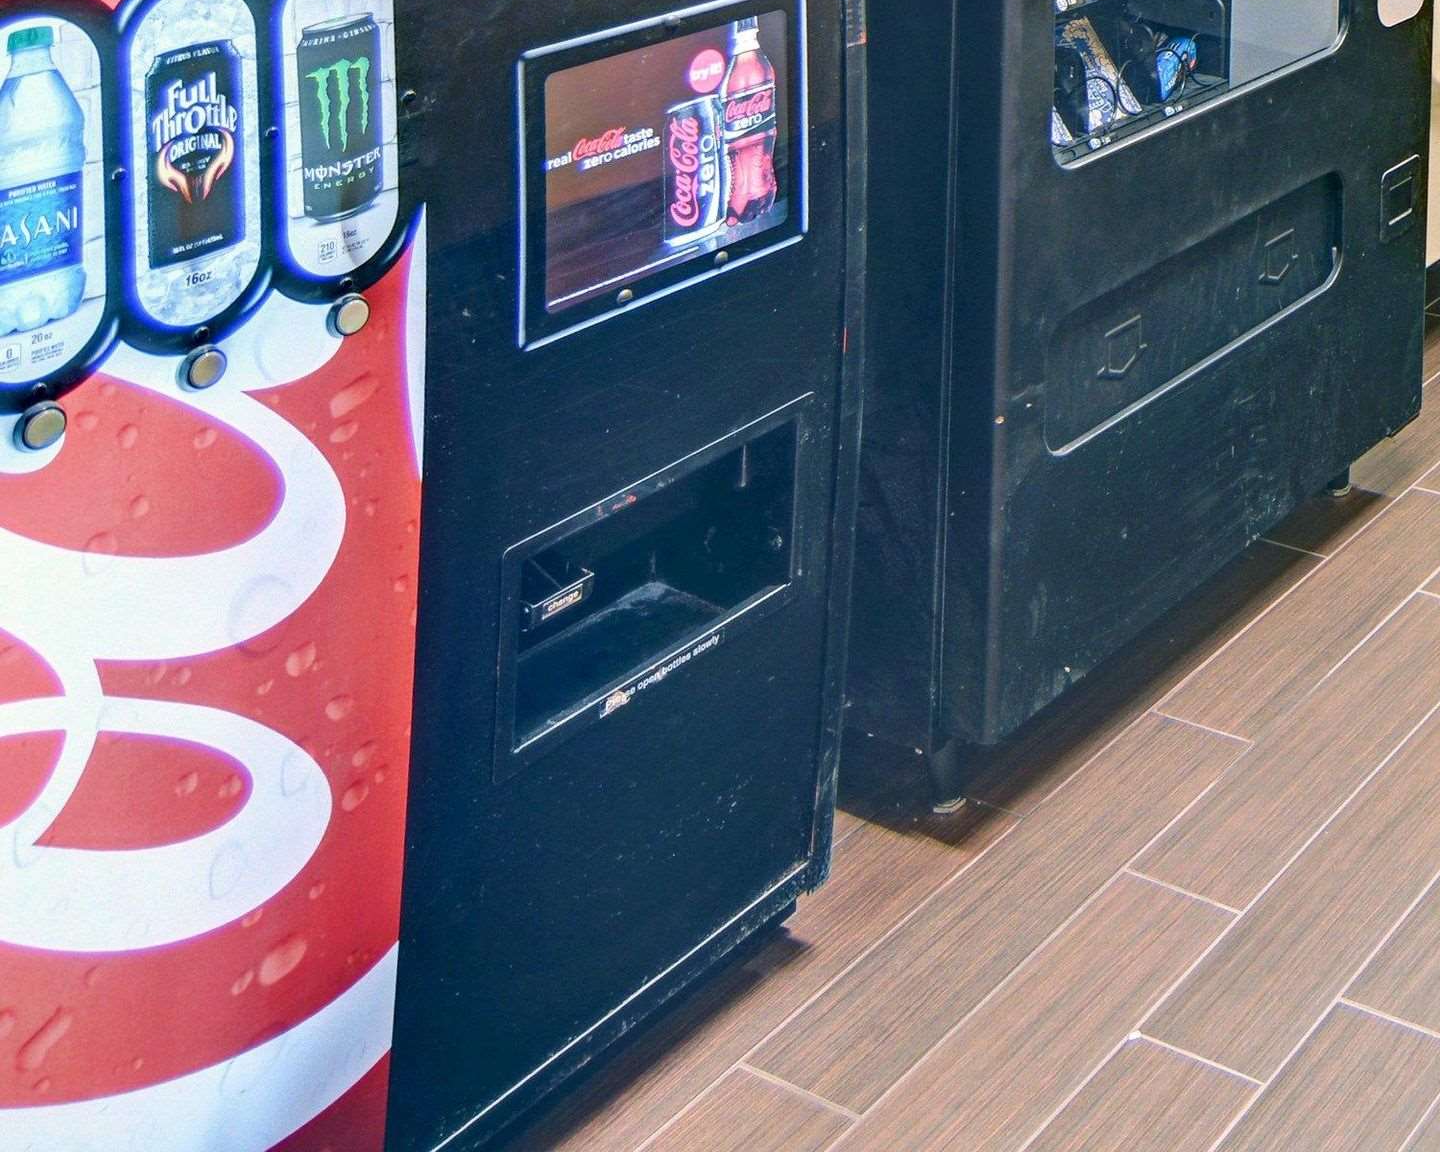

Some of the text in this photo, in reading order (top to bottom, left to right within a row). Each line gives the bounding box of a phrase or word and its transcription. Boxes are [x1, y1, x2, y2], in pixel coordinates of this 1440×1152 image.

[168, 72, 220, 116] Full
[153, 94, 238, 153] Throttle
[736, 113, 762, 130] zero
[170, 133, 221, 162] ORIGINAL
[305, 147, 380, 181] MONSTER
[547, 126, 653, 170] real Coca-Cola taste
[583, 136, 661, 169] zero calories
[314, 167, 374, 189] ENERGY
[669, 116, 699, 227] Coca-Cola
[700, 136, 715, 197] zero
[0, 206, 78, 248] ASANI
[186, 272, 212, 287] 16oz
[32, 333, 43, 344] 20
[548, 590, 579, 612] change
[662, 652, 691, 675] bottles
[693, 634, 720, 657] slowly
